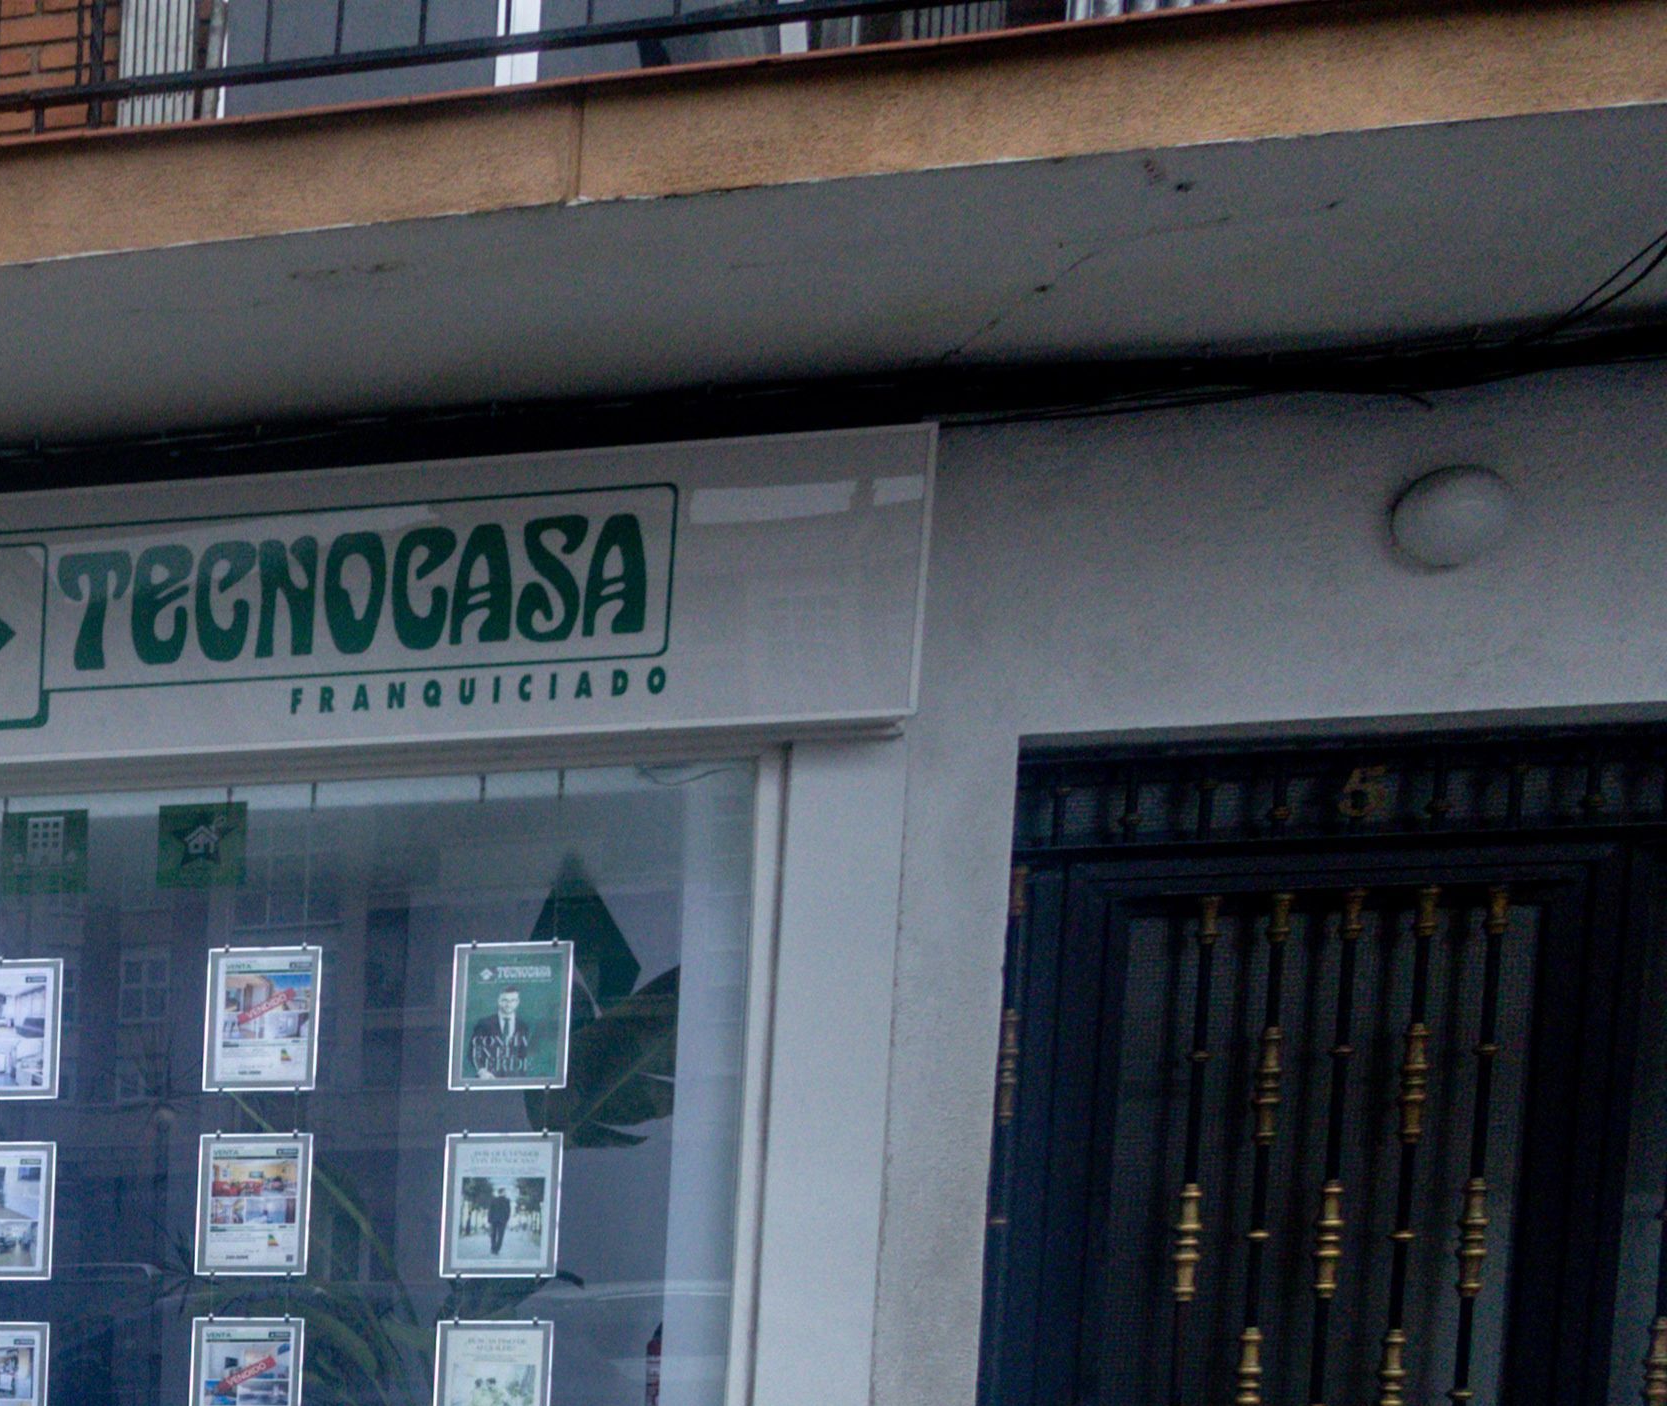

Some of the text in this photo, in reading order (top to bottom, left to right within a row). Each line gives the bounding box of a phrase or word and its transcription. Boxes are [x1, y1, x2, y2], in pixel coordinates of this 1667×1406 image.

[57, 513, 648, 671] TECNOCASA
[290, 665, 667, 716] FRANQUICIADO
[227, 1362, 267, 1386] VENDIDO
